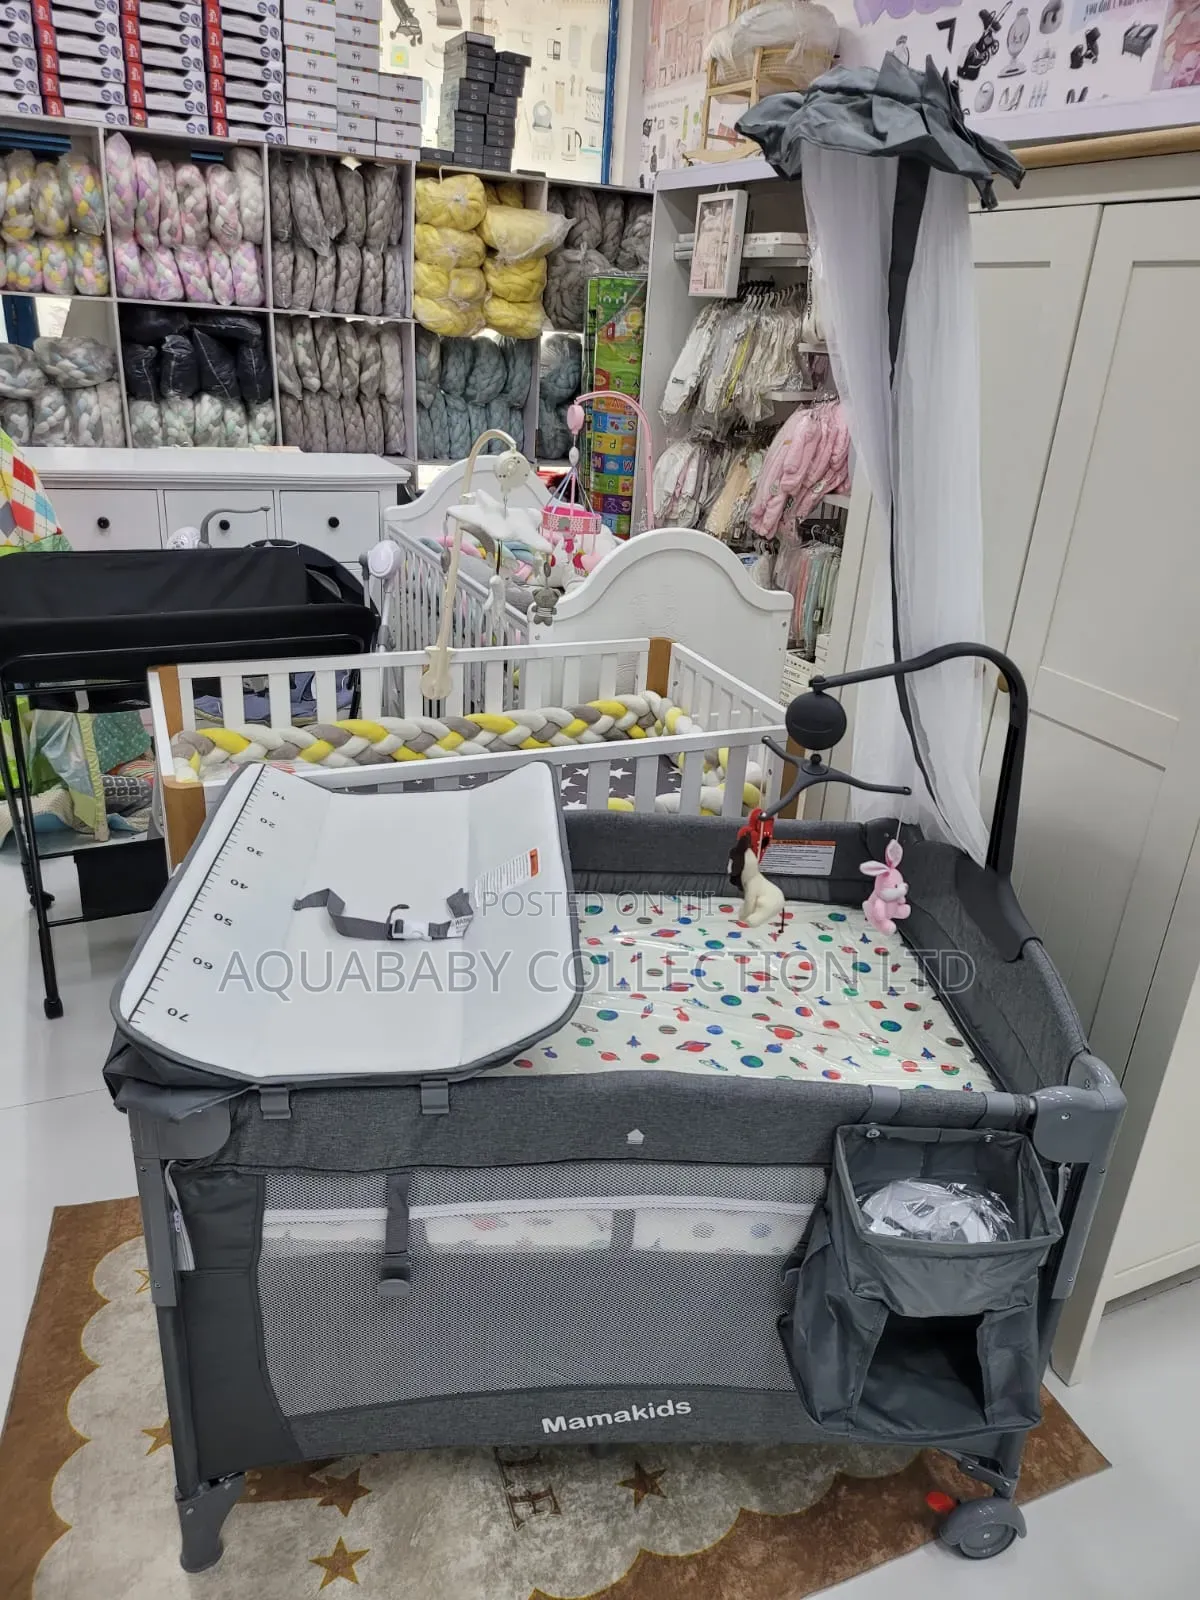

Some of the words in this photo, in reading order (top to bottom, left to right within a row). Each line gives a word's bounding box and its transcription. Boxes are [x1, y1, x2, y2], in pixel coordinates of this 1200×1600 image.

[260, 817, 277, 829] 20
[246, 846, 264, 857] 30
[230, 878, 249, 890] 40
[213, 912, 233, 927] 50
[192, 956, 214, 971] 60
[167, 1007, 190, 1023] 70
[541, 1399, 692, 1434] Mamakids
